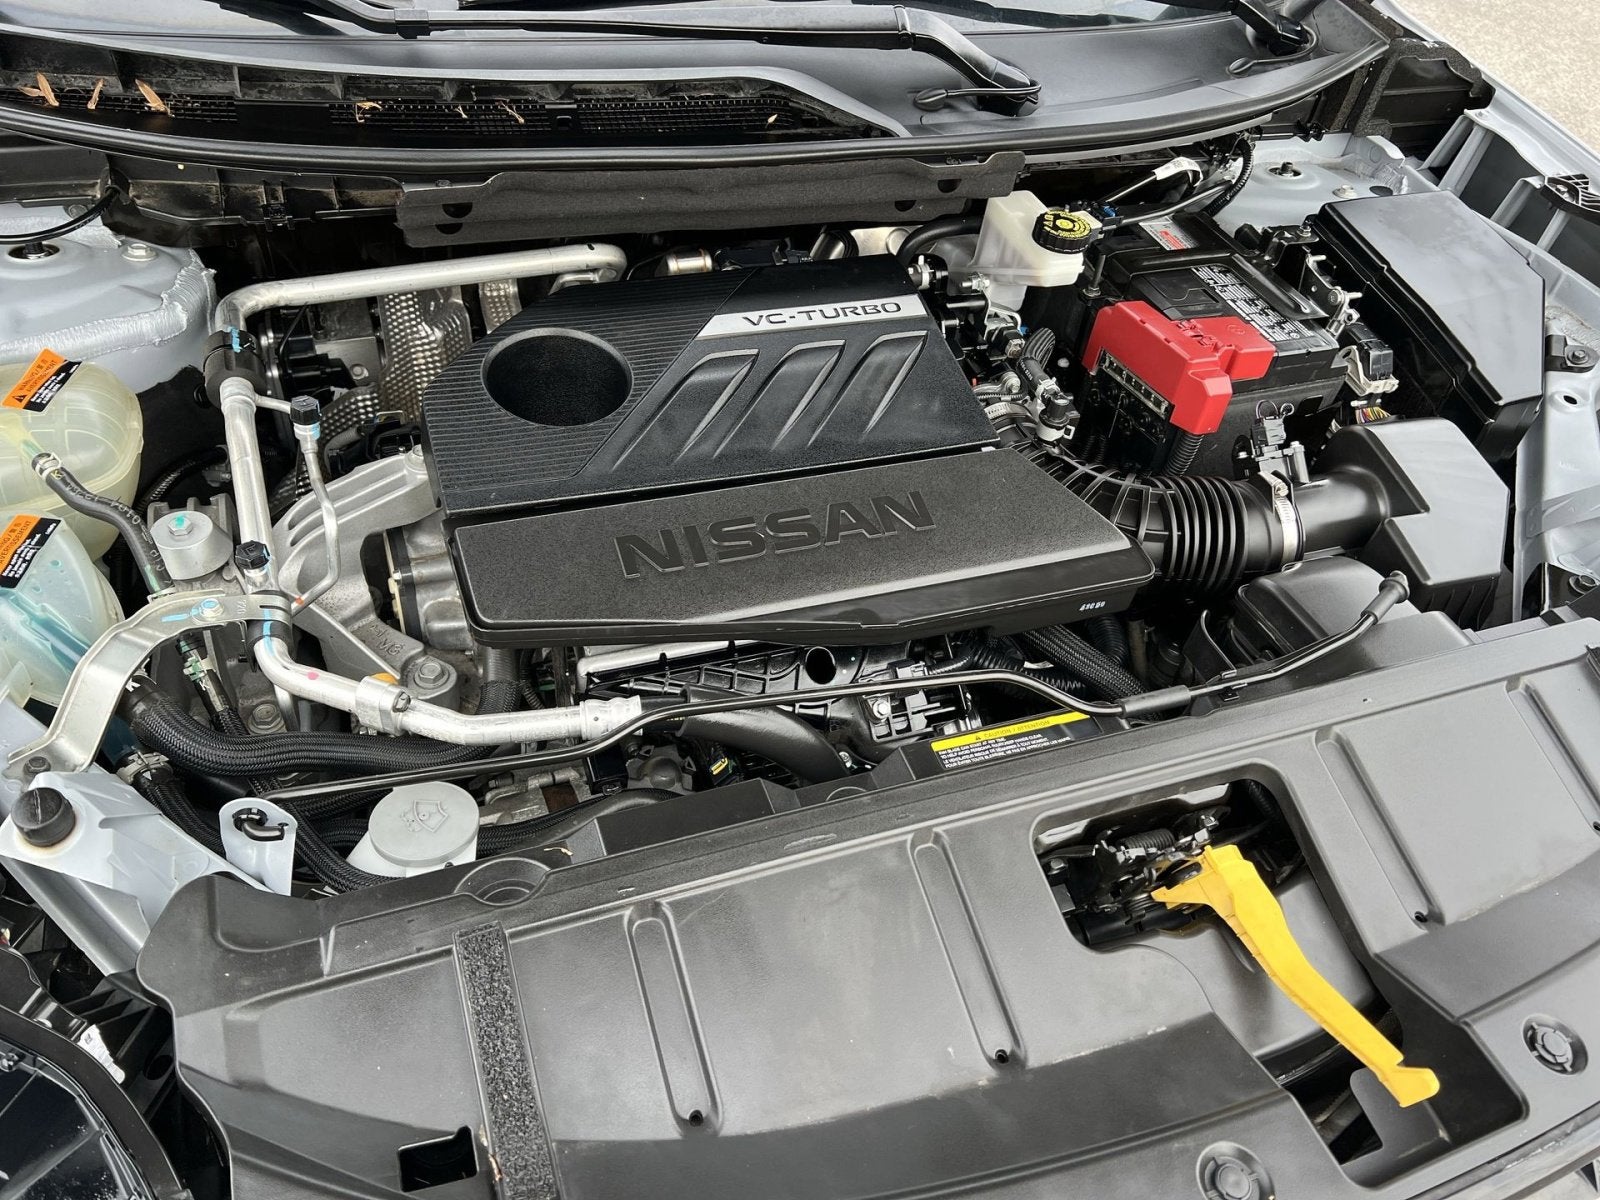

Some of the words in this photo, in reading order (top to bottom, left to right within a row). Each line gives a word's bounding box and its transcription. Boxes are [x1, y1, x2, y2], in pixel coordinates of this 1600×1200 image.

[743, 301, 902, 327] VC-TURBO
[613, 490, 937, 579] NISSAN
[983, 728, 1011, 738] CAUTION
[1016, 720, 1050, 731] ATTENTION
